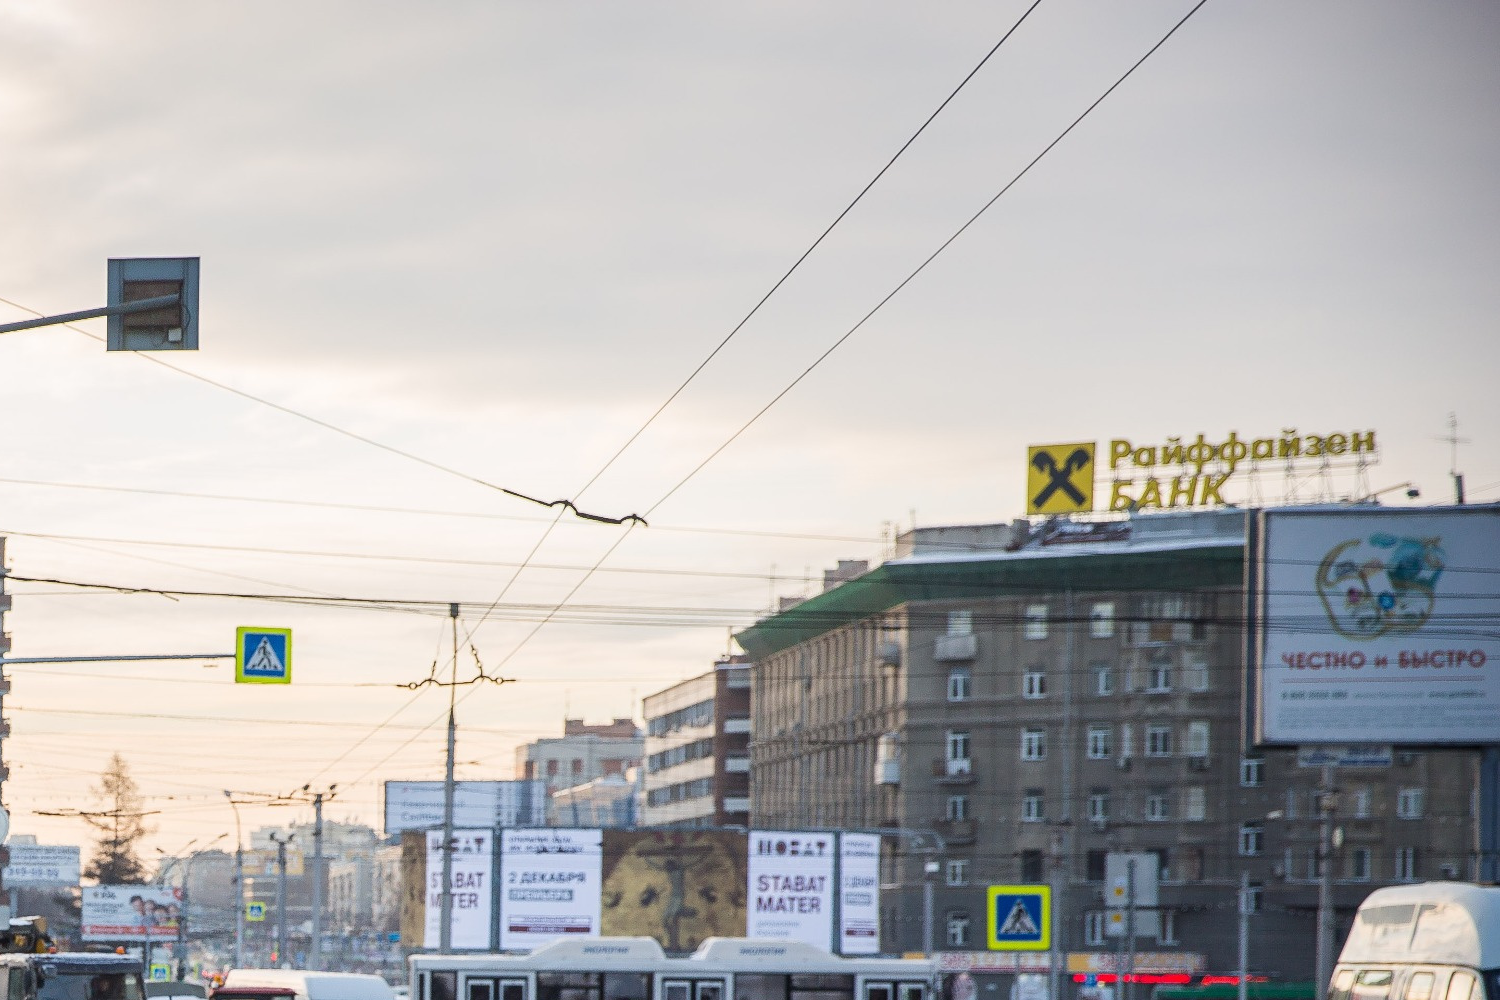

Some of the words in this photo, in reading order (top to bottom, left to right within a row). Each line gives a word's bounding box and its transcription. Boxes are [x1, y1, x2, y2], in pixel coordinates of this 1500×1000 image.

[1109, 428, 1375, 474] Райффайзен
[1109, 470, 1233, 511] БАНК
[1281, 650, 1367, 670] ЧЕСТНО
[1374, 655, 1388, 669] и
[1398, 649, 1487, 669] БЫСТРО
[508, 872, 519, 883] 2
[520, 871, 586, 885] ДЕКАБРЯ
[757, 874, 826, 892] STABAT
[431, 892, 479, 909] MTER
[757, 896, 822, 913] MATER
